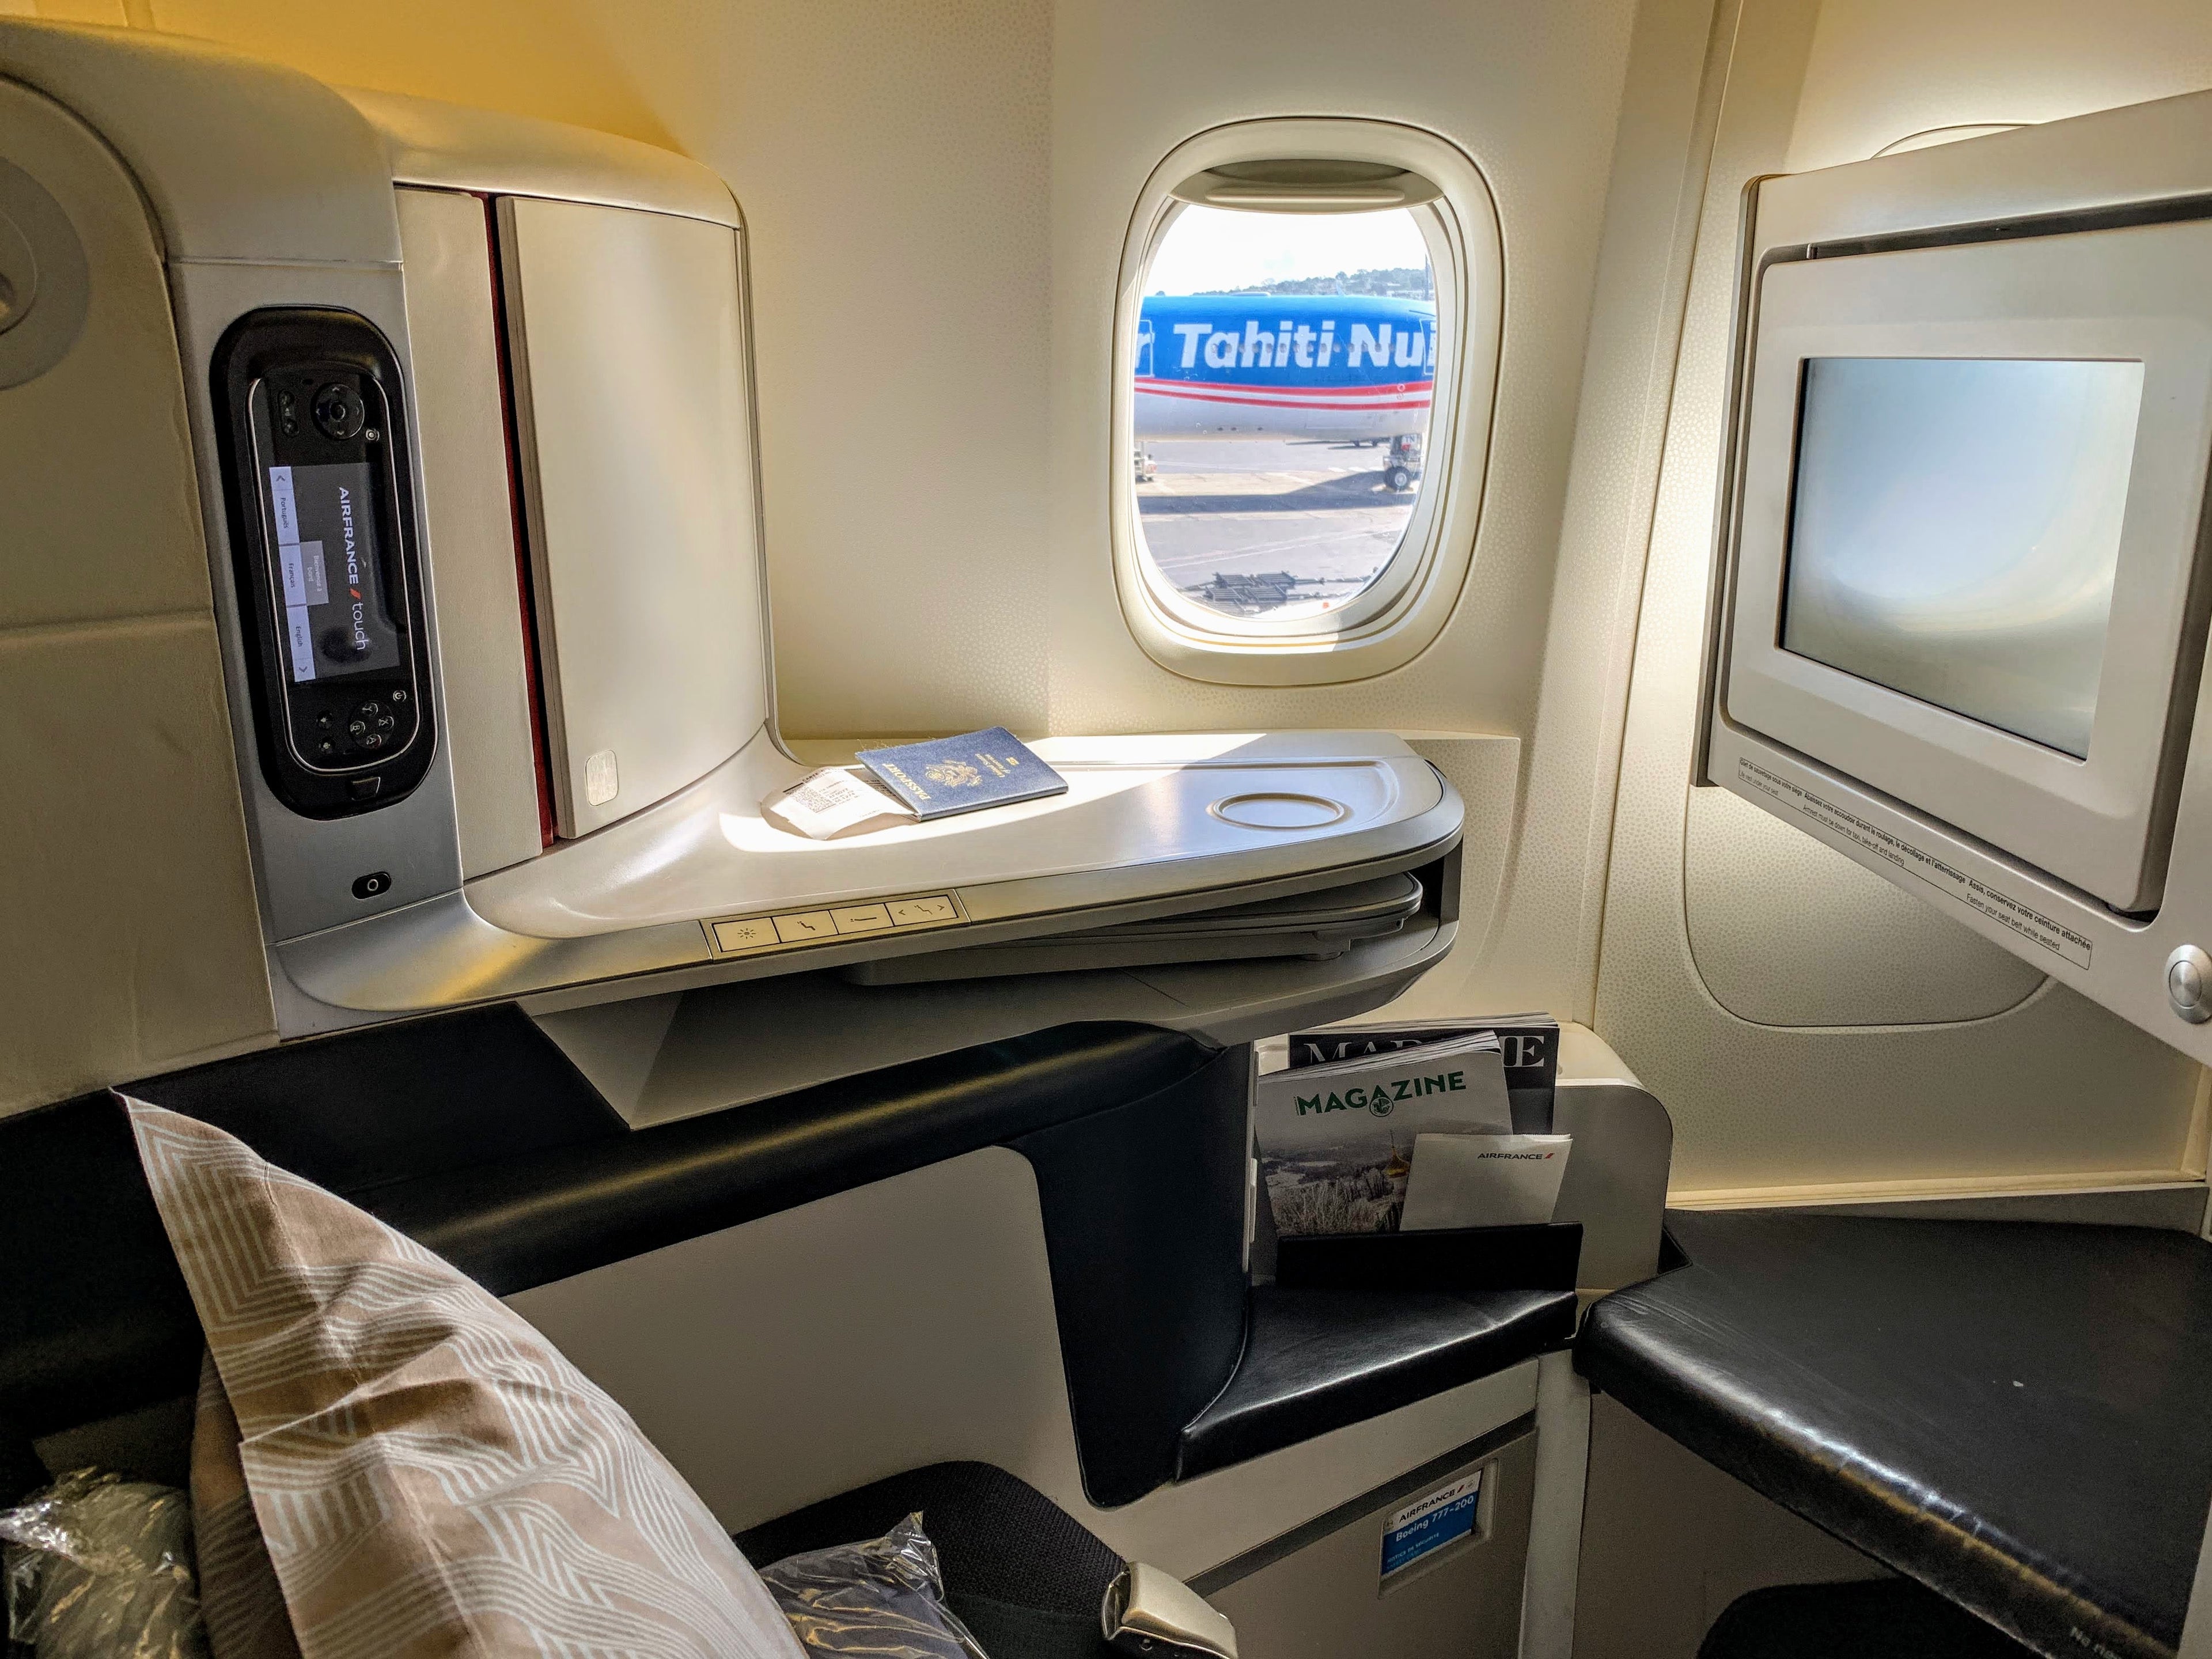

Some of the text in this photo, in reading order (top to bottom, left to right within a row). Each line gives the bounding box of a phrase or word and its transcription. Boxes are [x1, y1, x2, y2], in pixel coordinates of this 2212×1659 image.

[1173, 320, 1336, 369] Tahiti
[339, 487, 369, 650] AIRFRANCE touch
[882, 763, 931, 800] PASSPORT
[1823, 803, 1834, 813] votre
[1834, 809, 1855, 824] accoudoir
[1855, 820, 1870, 833] durant
[1871, 827, 1876, 835] le
[1876, 831, 1895, 847] roulage,
[1896, 840, 1900, 849] le
[1901, 843, 1925, 861] décollage
[1925, 857, 1931, 865] et
[1931, 859, 1965, 884] l'atterrissage
[1879, 847, 1888, 855] and
[1888, 850, 1904, 866] landing
[1967, 893, 2061, 951] Fasten your seat belt while seated
[1968, 880, 2090, 950] Assis, conservez votre ceinture attachée
[1297, 1071, 1467, 1116] MAGAZINE
[1395, 1495, 1474, 1543] Boeing 777-200
[1399, 1489, 1455, 1523] AIRFRANCE
